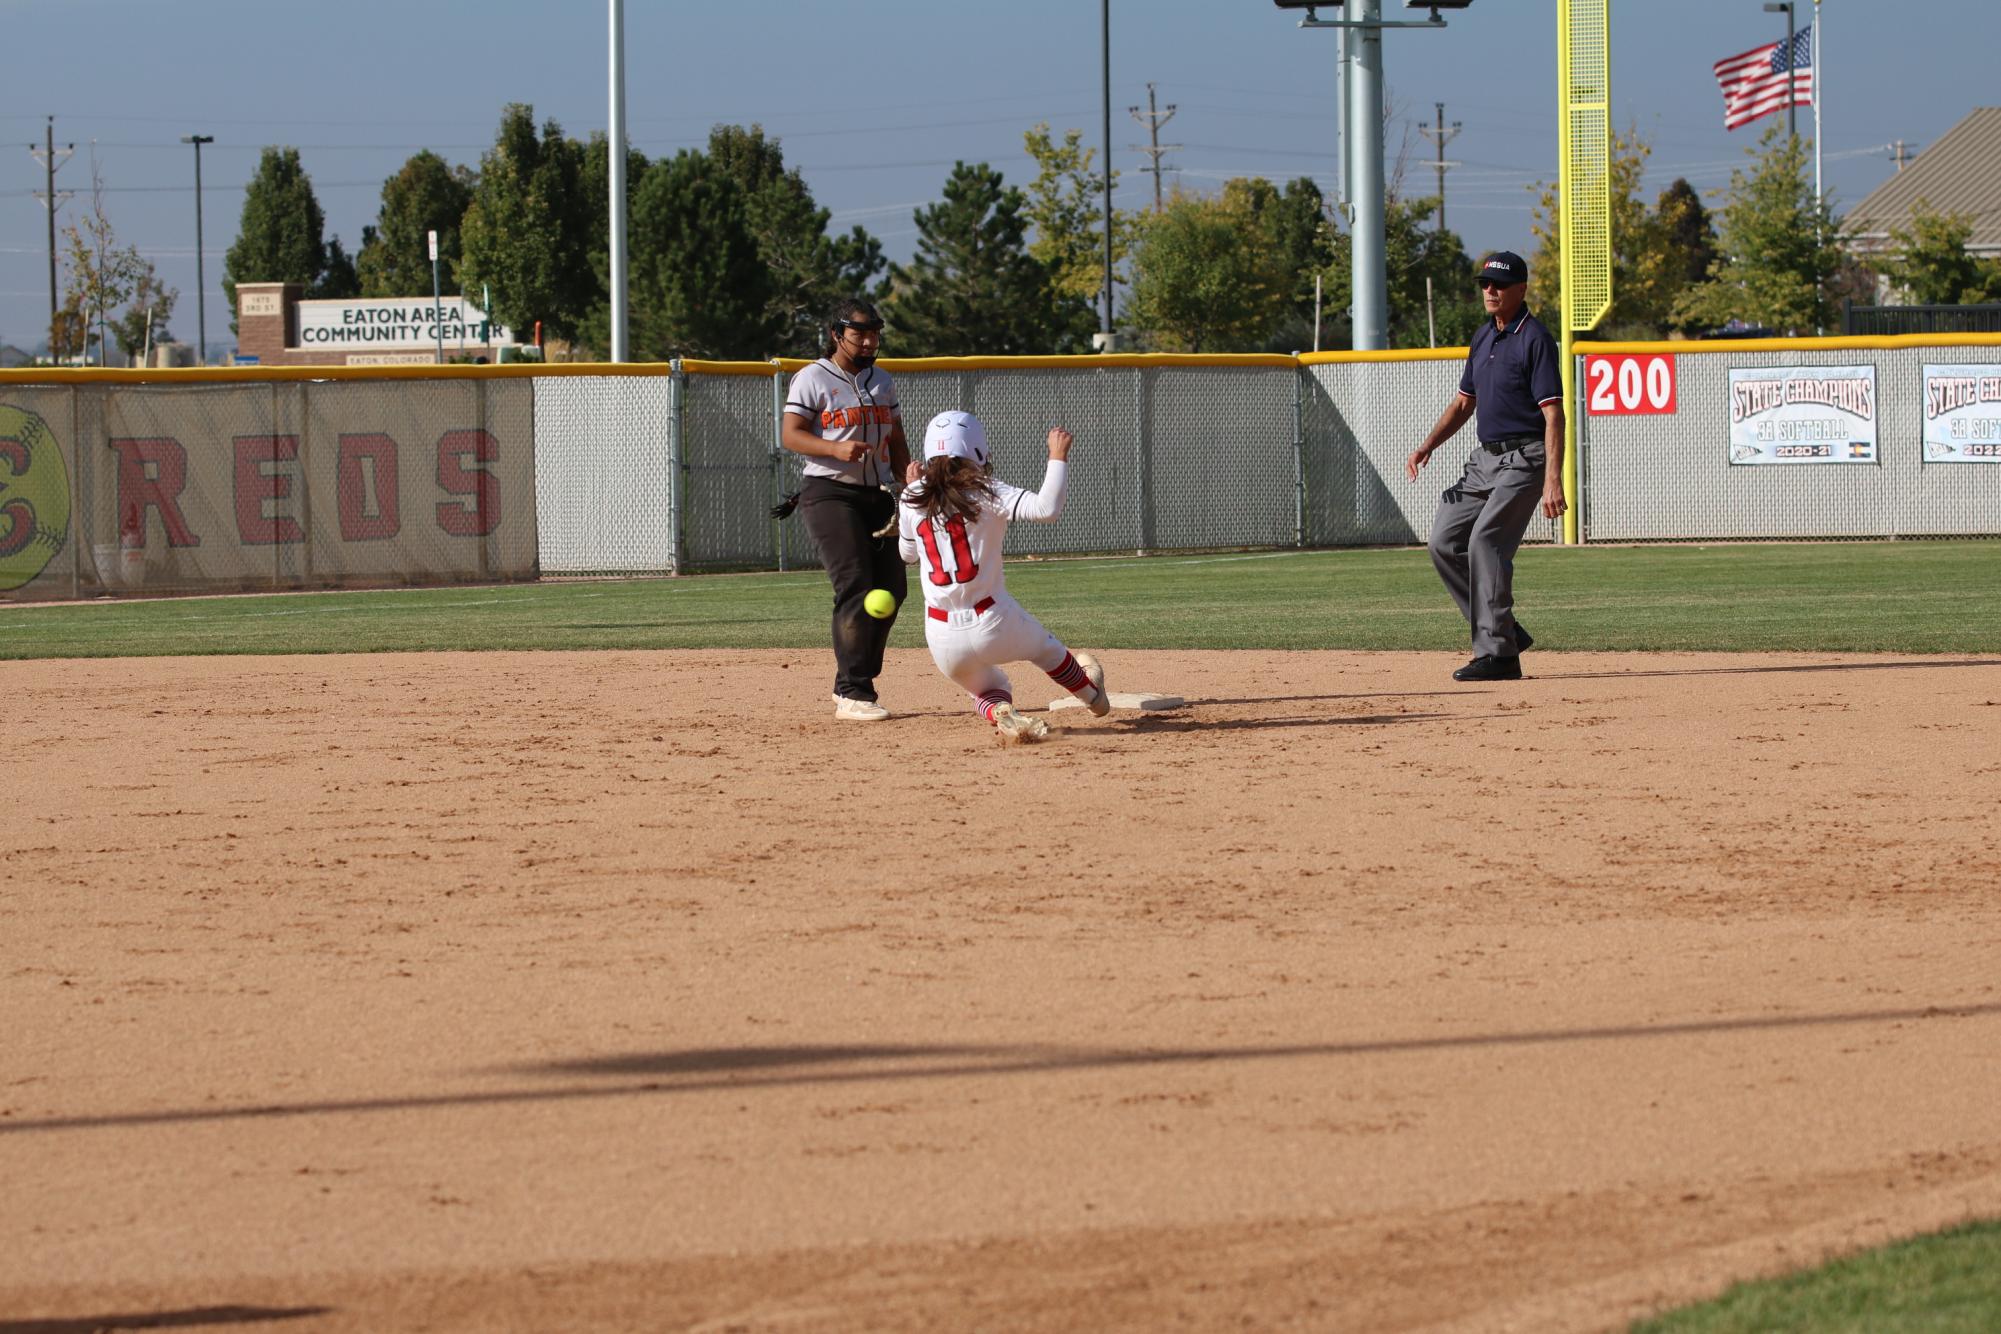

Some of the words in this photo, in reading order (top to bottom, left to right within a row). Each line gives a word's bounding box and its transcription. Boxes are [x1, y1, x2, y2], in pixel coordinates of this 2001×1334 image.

[343, 308, 406, 324] EATON
[411, 307, 461, 322] AREA
[302, 324, 421, 343] COMMUNITY
[428, 323, 504, 340] CENTR
[383, 355, 431, 364] COLORADO
[1590, 357, 1671, 411] 200
[1733, 379, 1783, 423] STATE
[1784, 377, 1872, 421] CHAMPIONS
[1927, 377, 1976, 420] STATE
[1757, 421, 1775, 441] 3A
[1779, 419, 1848, 440] SOFTBALL
[1951, 418, 1967, 439] 3A
[1775, 445, 1832, 457] 2020-21
[109, 428, 500, 548] REDS
[916, 514, 979, 587] 11
